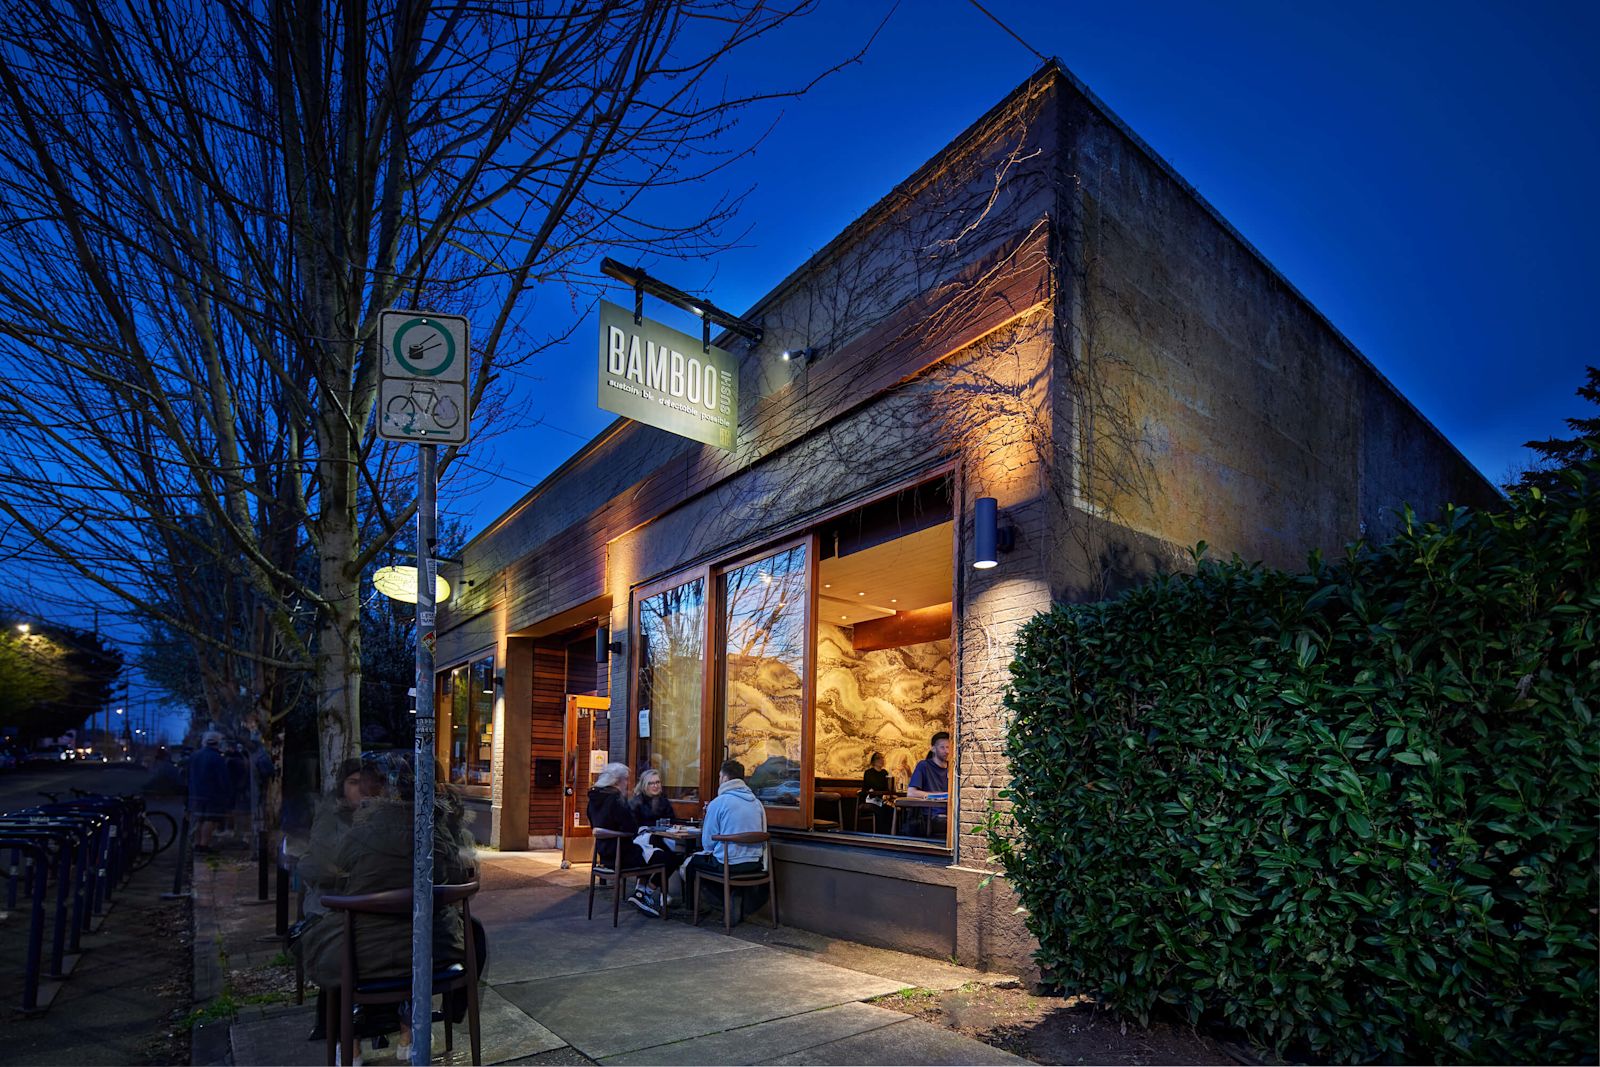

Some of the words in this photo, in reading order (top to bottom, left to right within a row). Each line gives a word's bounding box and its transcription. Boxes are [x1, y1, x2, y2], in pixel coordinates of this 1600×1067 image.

[608, 325, 717, 410] BAMBOO
[719, 370, 732, 416] SUSHI
[700, 411, 730, 428] possible
